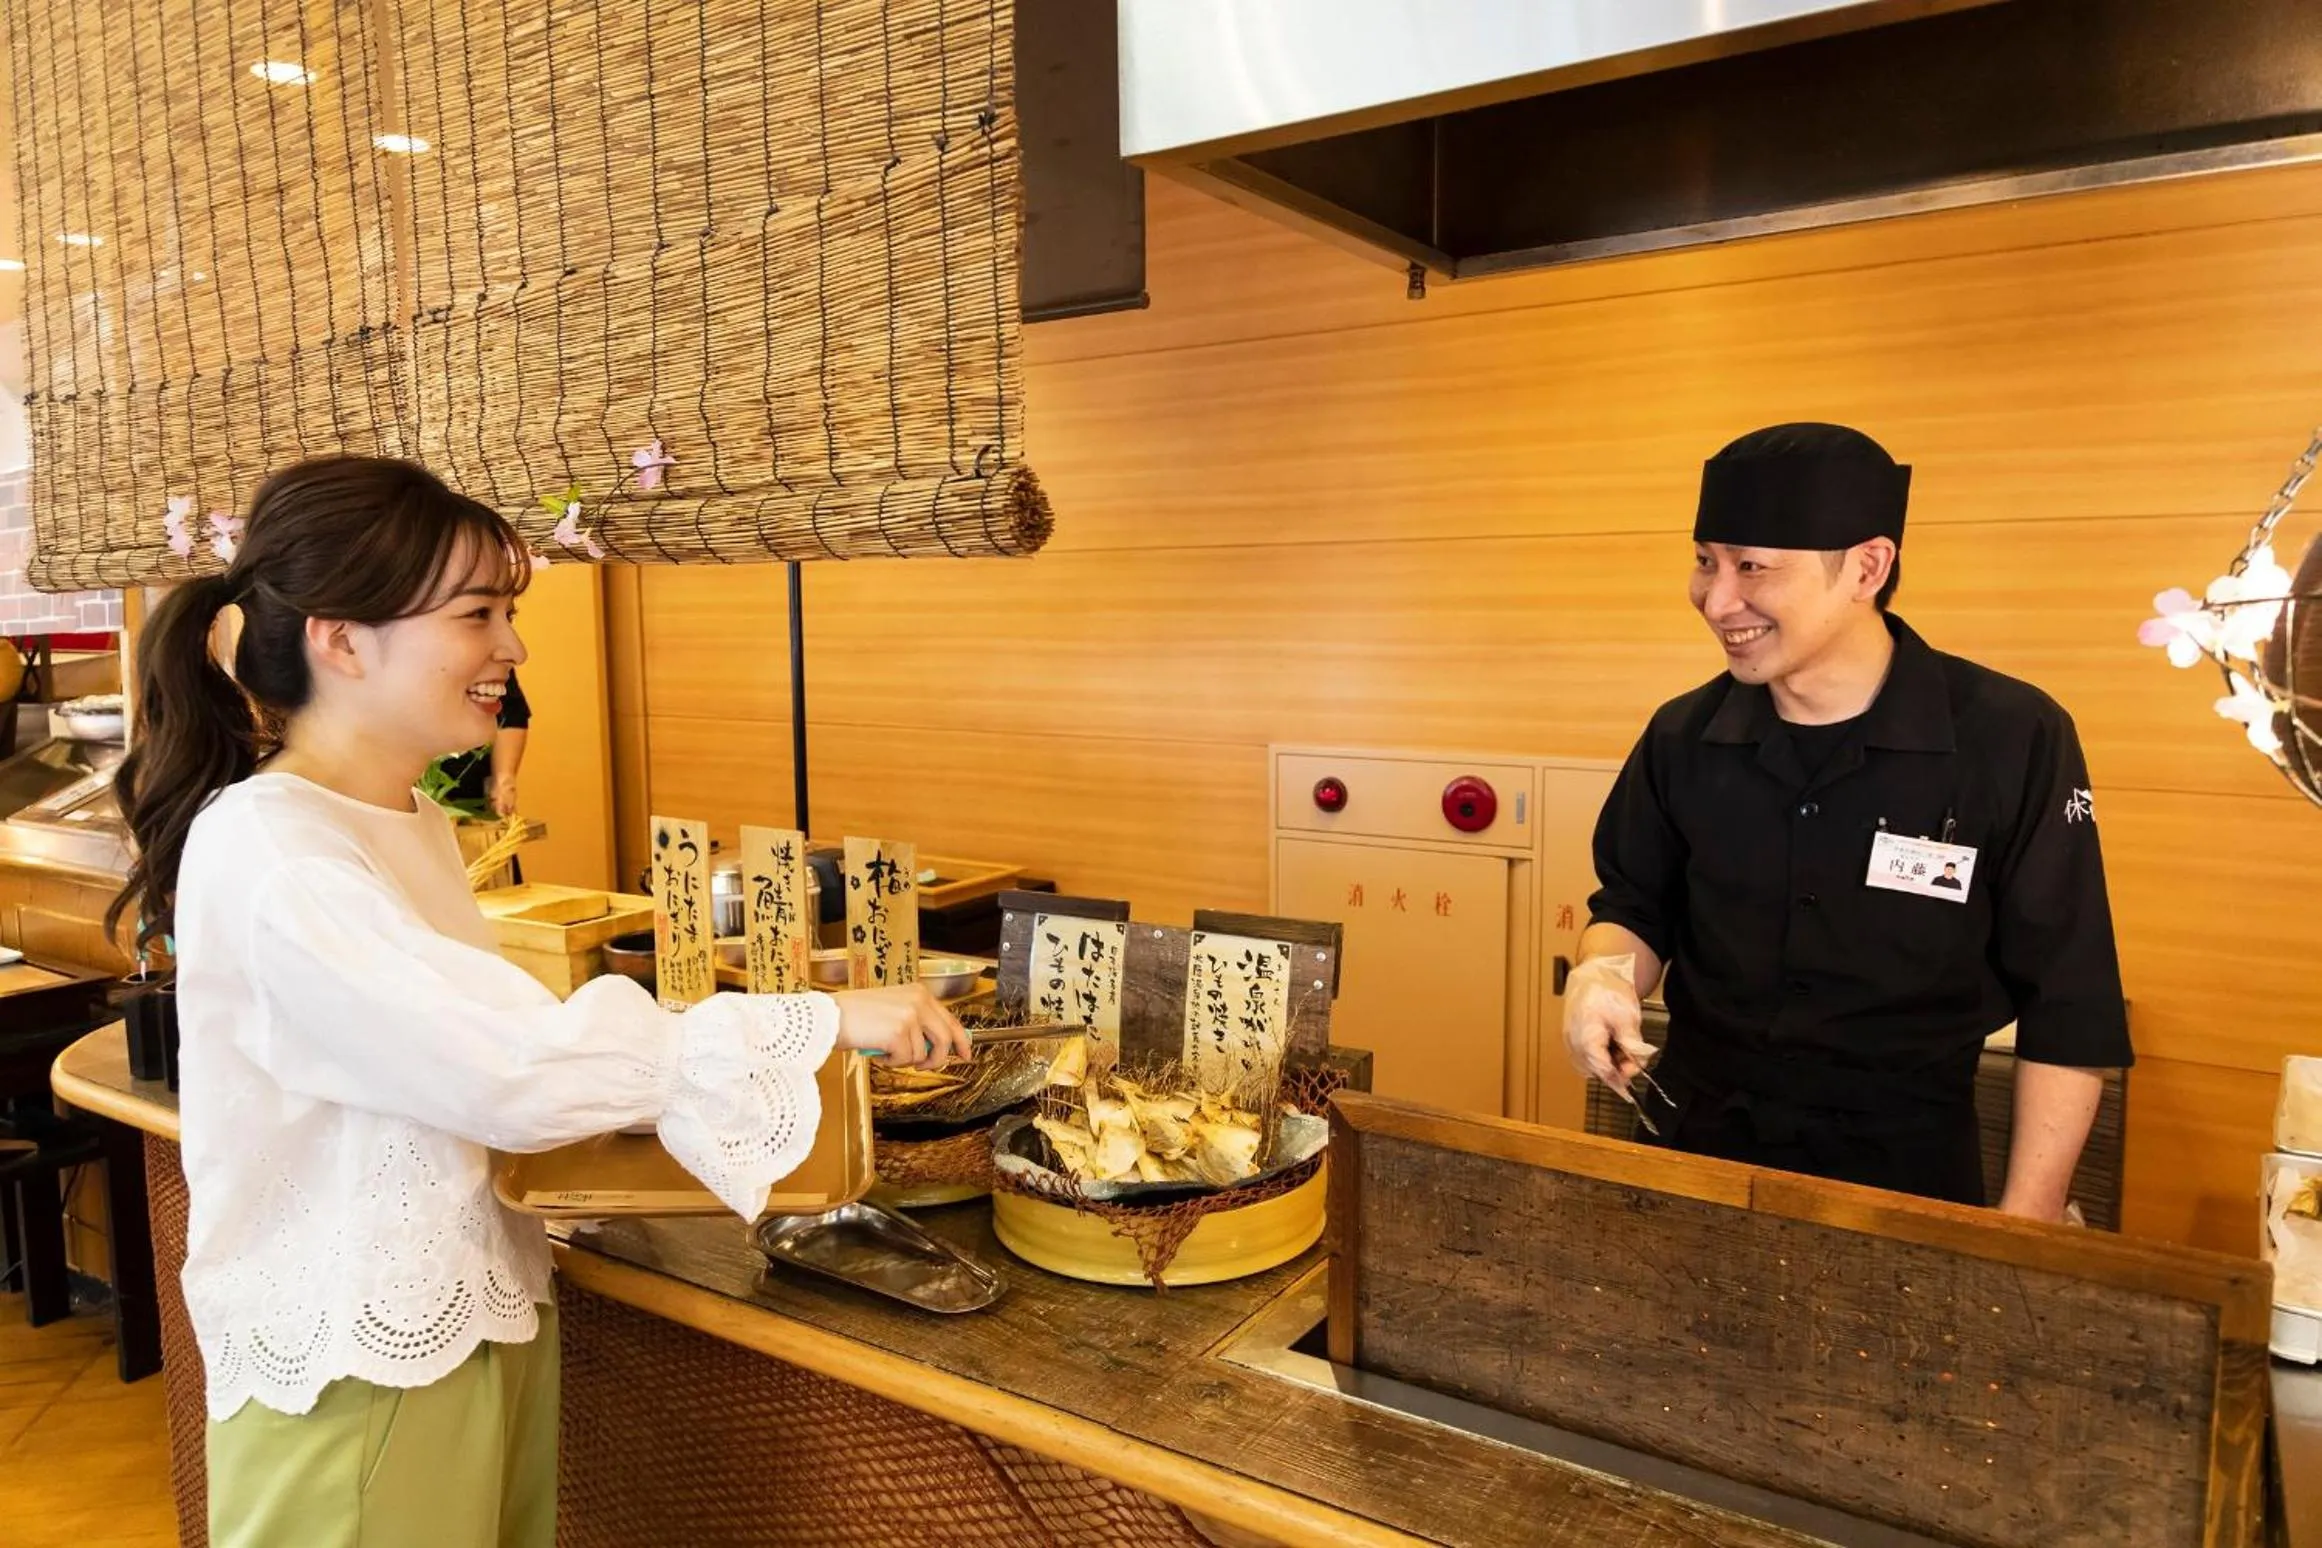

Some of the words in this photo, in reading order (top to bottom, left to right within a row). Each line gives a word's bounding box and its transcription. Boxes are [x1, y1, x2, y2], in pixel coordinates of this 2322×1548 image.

[663, 865, 684, 958] おにぎり
[865, 848, 902, 987] 梅おにぎり
[1347, 883, 1453, 918] 消火栓
